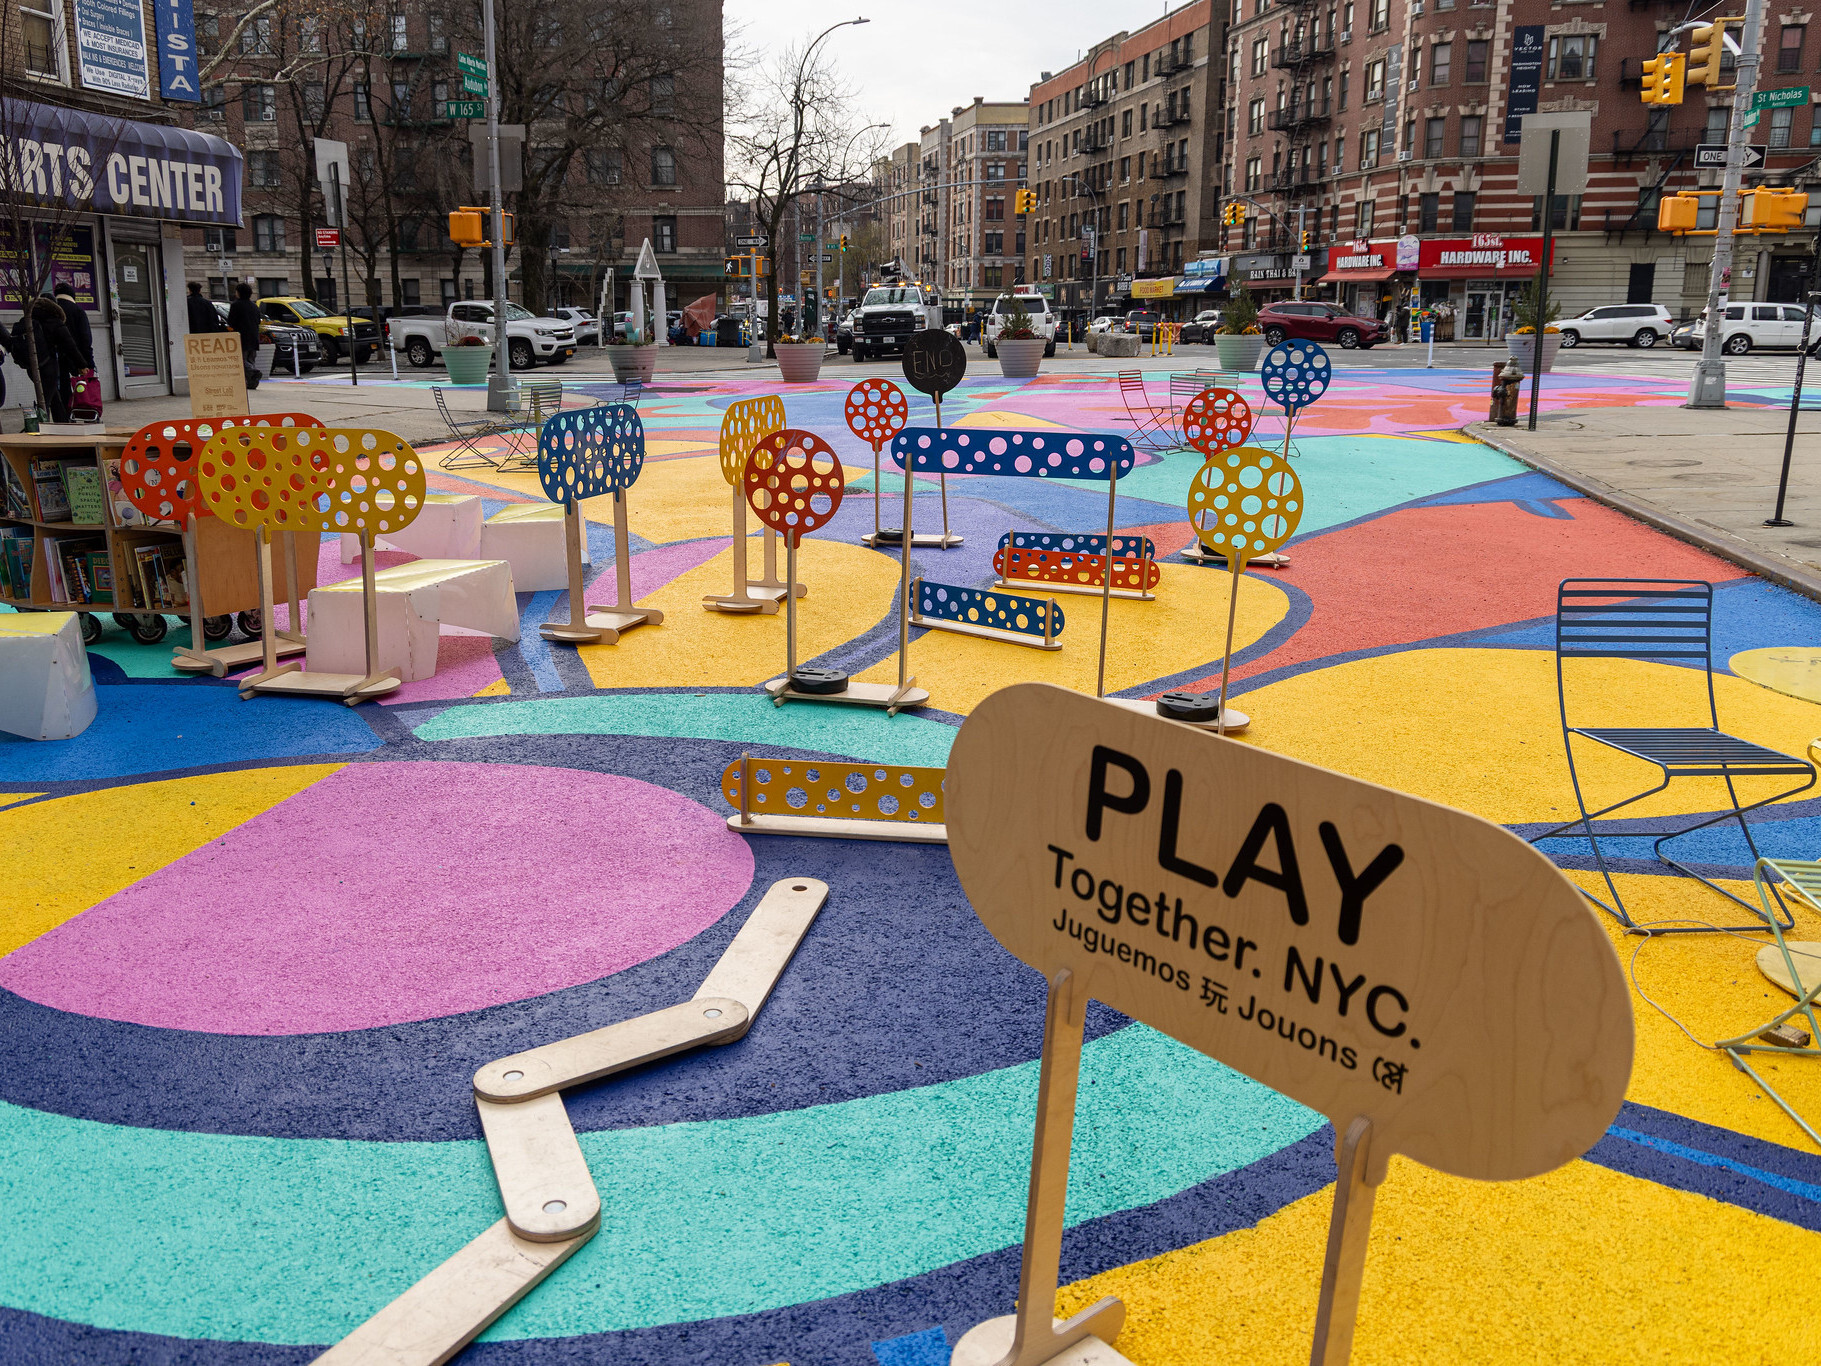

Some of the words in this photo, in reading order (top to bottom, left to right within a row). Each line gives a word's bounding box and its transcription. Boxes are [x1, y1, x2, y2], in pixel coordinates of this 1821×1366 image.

[90, 9, 105, 22] Surgery
[96, 1, 118, 14] Colored
[118, 7, 136, 20] Fillings
[82, 30, 92, 38] WE
[93, 32, 114, 43] ACCEPT
[115, 37, 140, 50] MEDICAID
[167, 0, 194, 92] ISTA
[92, 40, 106, 50] MOST
[107, 44, 139, 58] INSURANCES
[86, 66, 94, 74] We
[94, 68, 106, 77] Use
[108, 70, 127, 82] DIGITAL
[1757, 93, 1766, 103] St
[1769, 90, 1803, 101] Nicholas
[449, 103, 456, 116] W
[460, 103, 474, 116] 165
[1703, 152, 1723, 161] ONE
[106, 152, 224, 213] CENTER
[1336, 255, 1370, 269] HARDWARE
[1370, 254, 1383, 267] INC.
[1440, 250, 1507, 265] HARDWARE
[1508, 250, 1533, 264] INC.
[1250, 270, 1264, 279] RAIN
[1266, 269, 1280, 278] THAI
[187, 338, 238, 355] READ
[1086, 744, 1405, 946] PLAY
[1048, 844, 1262, 978] Together.
[1284, 946, 1421, 1050] NYC.
[1052, 909, 1190, 991] Juguemos
[1200, 976, 1228, 1014] 玩
[1238, 996, 1358, 1070] Jouons
